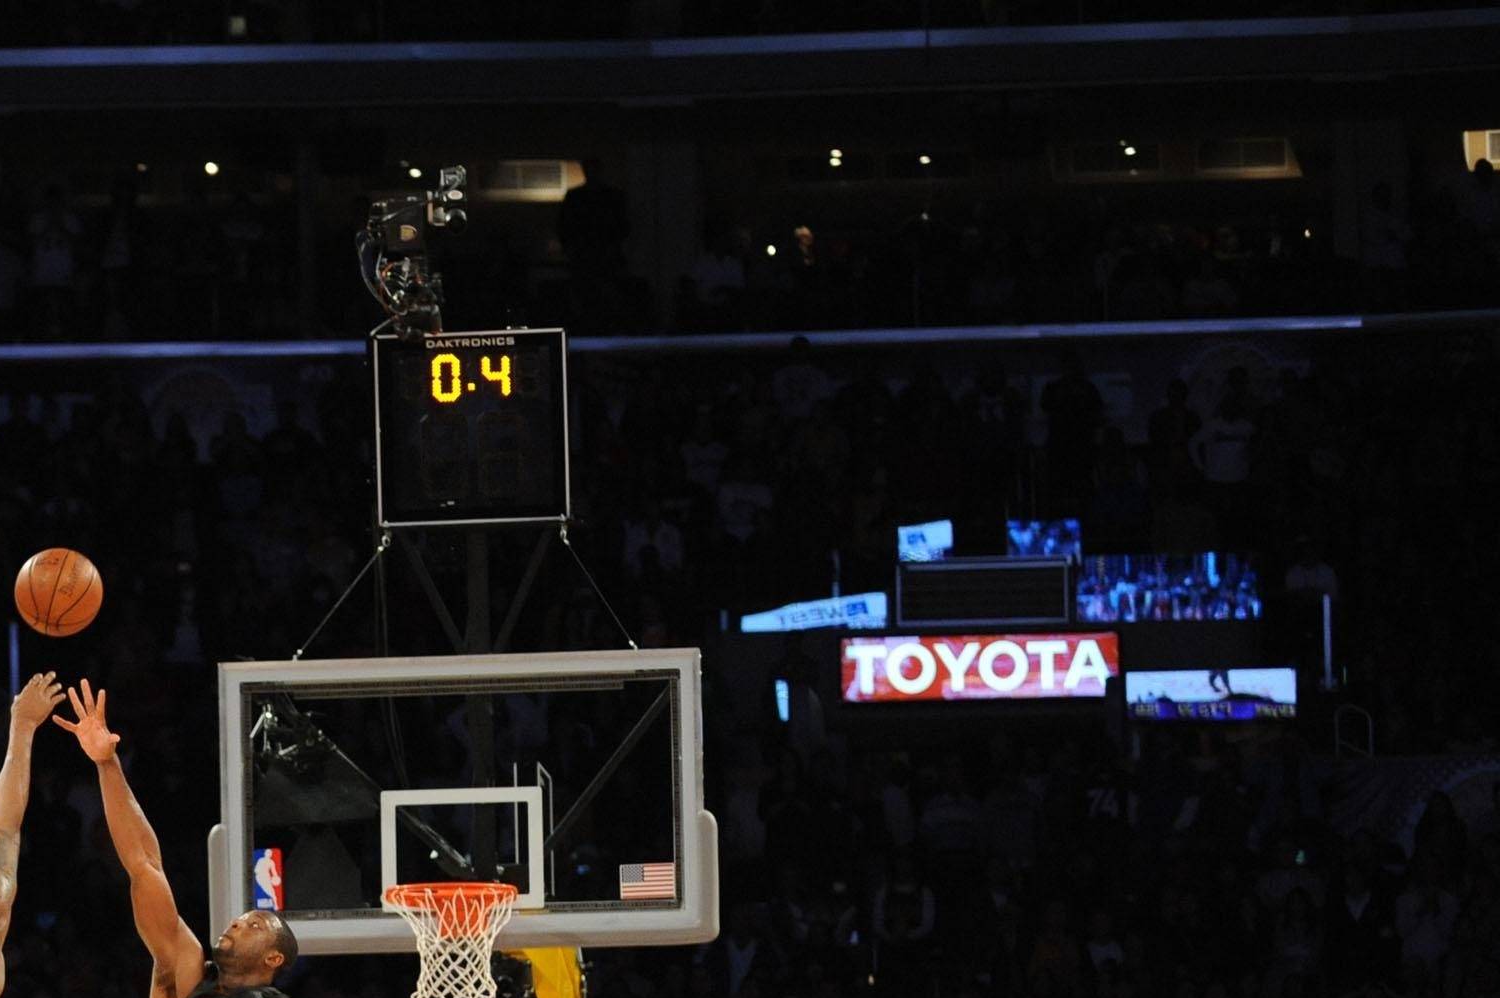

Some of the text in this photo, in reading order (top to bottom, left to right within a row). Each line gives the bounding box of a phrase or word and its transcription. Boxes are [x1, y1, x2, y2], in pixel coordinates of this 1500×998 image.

[425, 336, 515, 349] DAKTRONICS
[431, 353, 511, 402] 0.4
[845, 639, 1110, 695] TOYOTA
